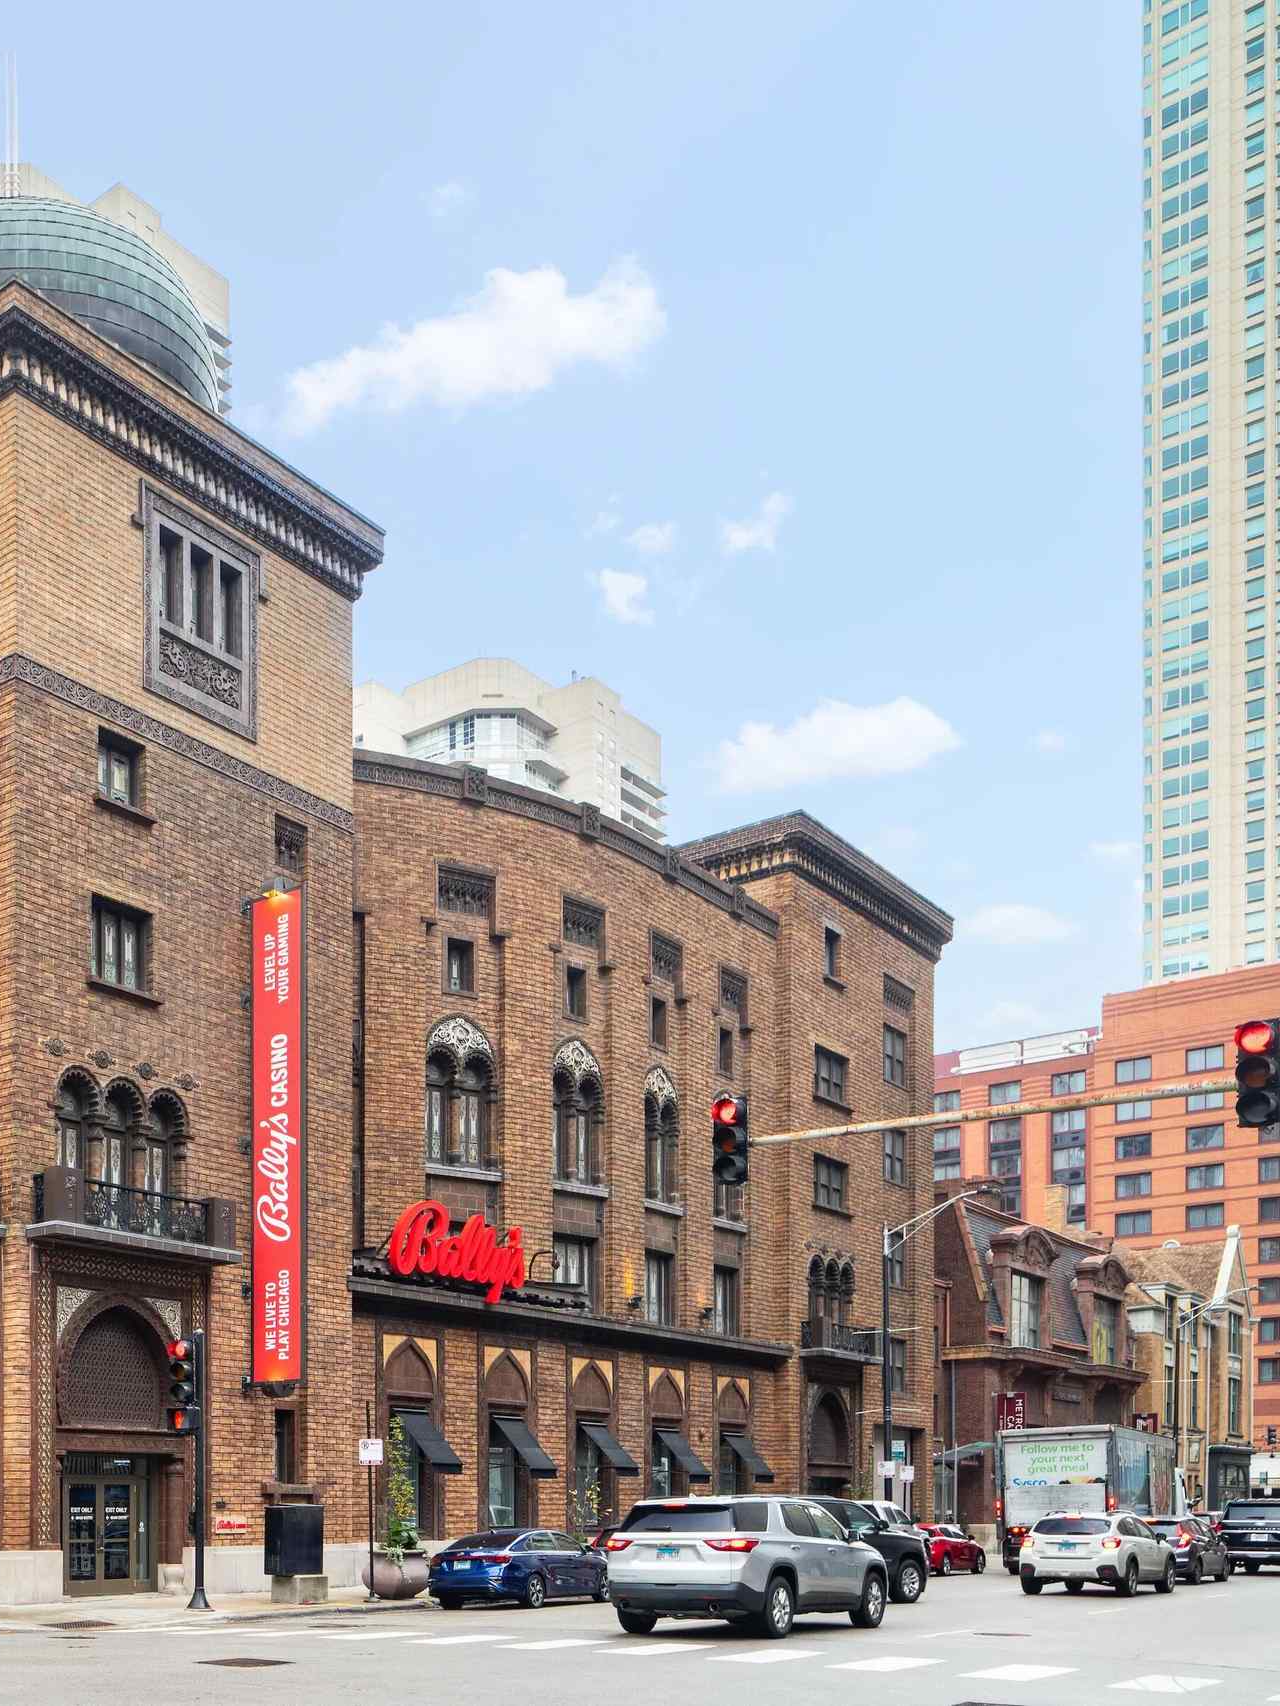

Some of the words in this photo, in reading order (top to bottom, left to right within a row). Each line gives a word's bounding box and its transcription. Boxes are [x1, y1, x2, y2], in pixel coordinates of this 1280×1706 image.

[264, 933, 275, 952] UP
[277, 912, 289, 967] GAMING
[264, 953, 275, 992] LEVEL
[277, 967, 289, 1005] YOUR
[270, 1033, 289, 1108] CASINO
[256, 1112, 297, 1243] Bally's
[388, 1199, 525, 1305] Bally's
[264, 1282, 275, 1300] TO
[277, 1269, 290, 1327] CHICAGO
[264, 1302, 275, 1331] LIVE
[264, 1332, 276, 1351] WE
[277, 1329, 290, 1361] PLAY
[1021, 1444, 1058, 1455] Follow
[1061, 1444, 1079, 1452] me
[1082, 1443, 1094, 1452] to
[1031, 1456, 1056, 1466] your
[1060, 1454, 1086, 1463] next
[1027, 1464, 1058, 1475] great
[1061, 1463, 1089, 1473] meal
